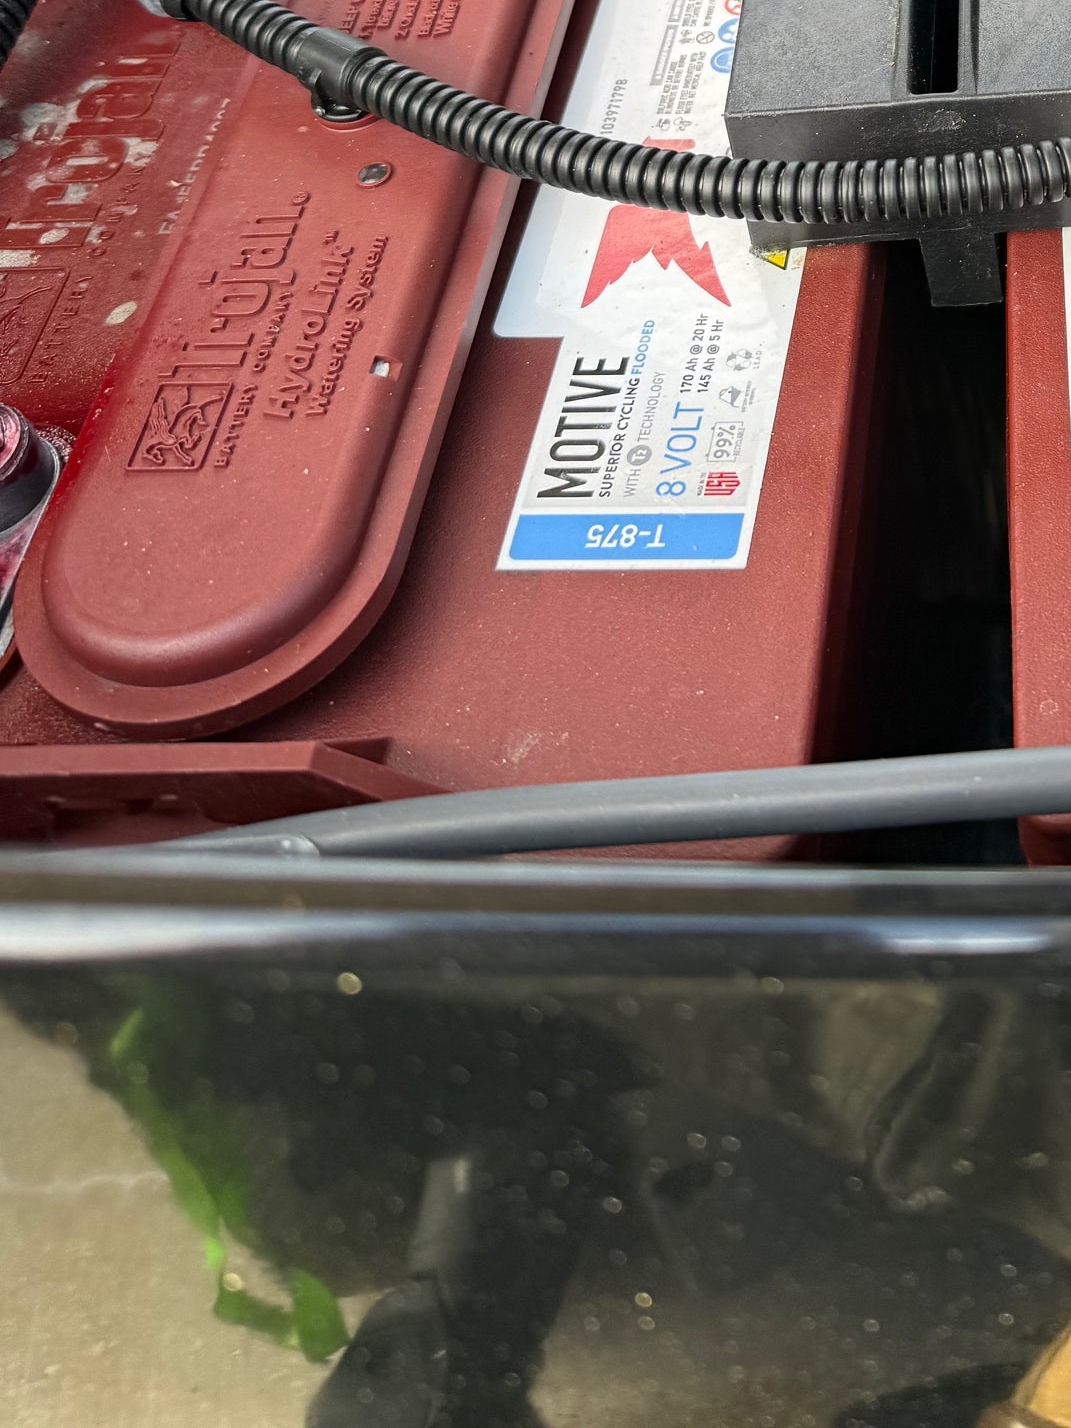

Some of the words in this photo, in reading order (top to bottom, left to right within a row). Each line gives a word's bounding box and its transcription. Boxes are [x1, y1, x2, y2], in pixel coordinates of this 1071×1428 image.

[157, 204, 306, 379] Trojan
[304, 317, 364, 418] Watering
[346, 235, 389, 312] System
[695, 313, 709, 324] Hr
[710, 319, 724, 331] Hr
[263, 245, 354, 419] HydroLink
[691, 328, 705, 341] 20
[684, 357, 699, 371] Ah
[701, 357, 715, 371] Ah
[678, 374, 695, 393] 170
[696, 374, 712, 393] 145
[596, 433, 627, 497] SUPERIOR
[614, 377, 641, 429] CYCLING
[629, 319, 657, 374] FLOODED
[213, 383, 258, 469] BATTERY
[537, 357, 630, 498] MOTIVE
[622, 468, 642, 496] WITH
[635, 371, 667, 442] TECHNOLOGY
[658, 401, 706, 473] VOLT
[712, 424, 737, 458] 99%
[653, 480, 688, 496] 8
[702, 471, 743, 496] USA
[584, 525, 666, 549] T-875
